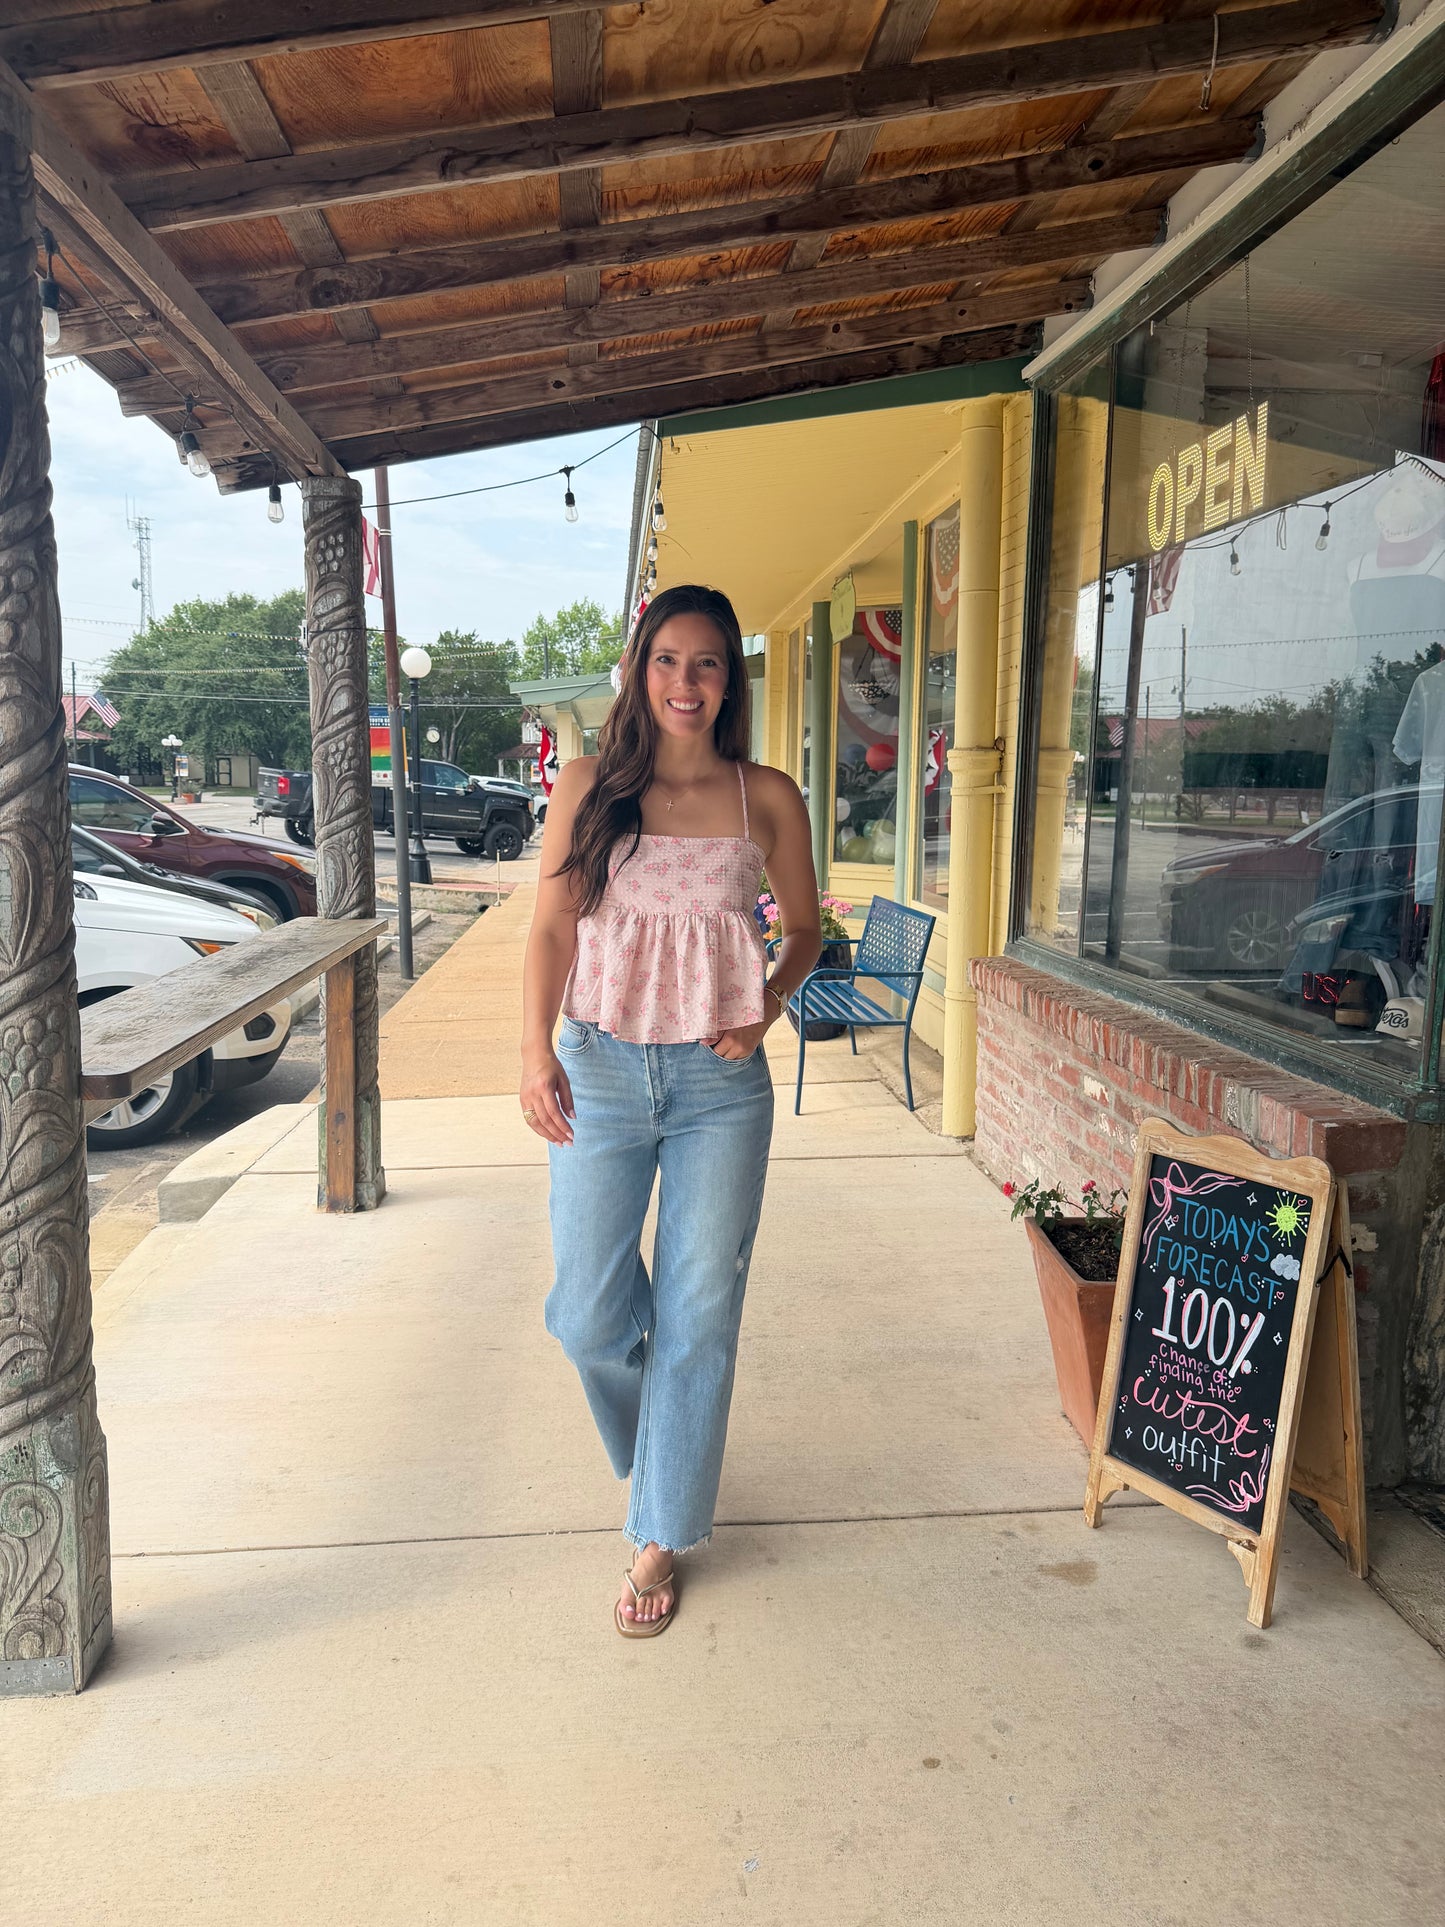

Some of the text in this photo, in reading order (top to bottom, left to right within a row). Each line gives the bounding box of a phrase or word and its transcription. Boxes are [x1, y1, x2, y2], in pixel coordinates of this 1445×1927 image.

[1147, 400, 1269, 551] OPEN
[1176, 1197, 1270, 1262] TODAY'S
[1156, 1236, 1282, 1309] FORECAST
[1152, 1276, 1266, 1379] 100%
[1149, 1354, 1237, 1403] finding the
[1213, 1367, 1228, 1385] of
[1133, 1376, 1259, 1458] cutest
[1142, 1425, 1226, 1482] outfit
